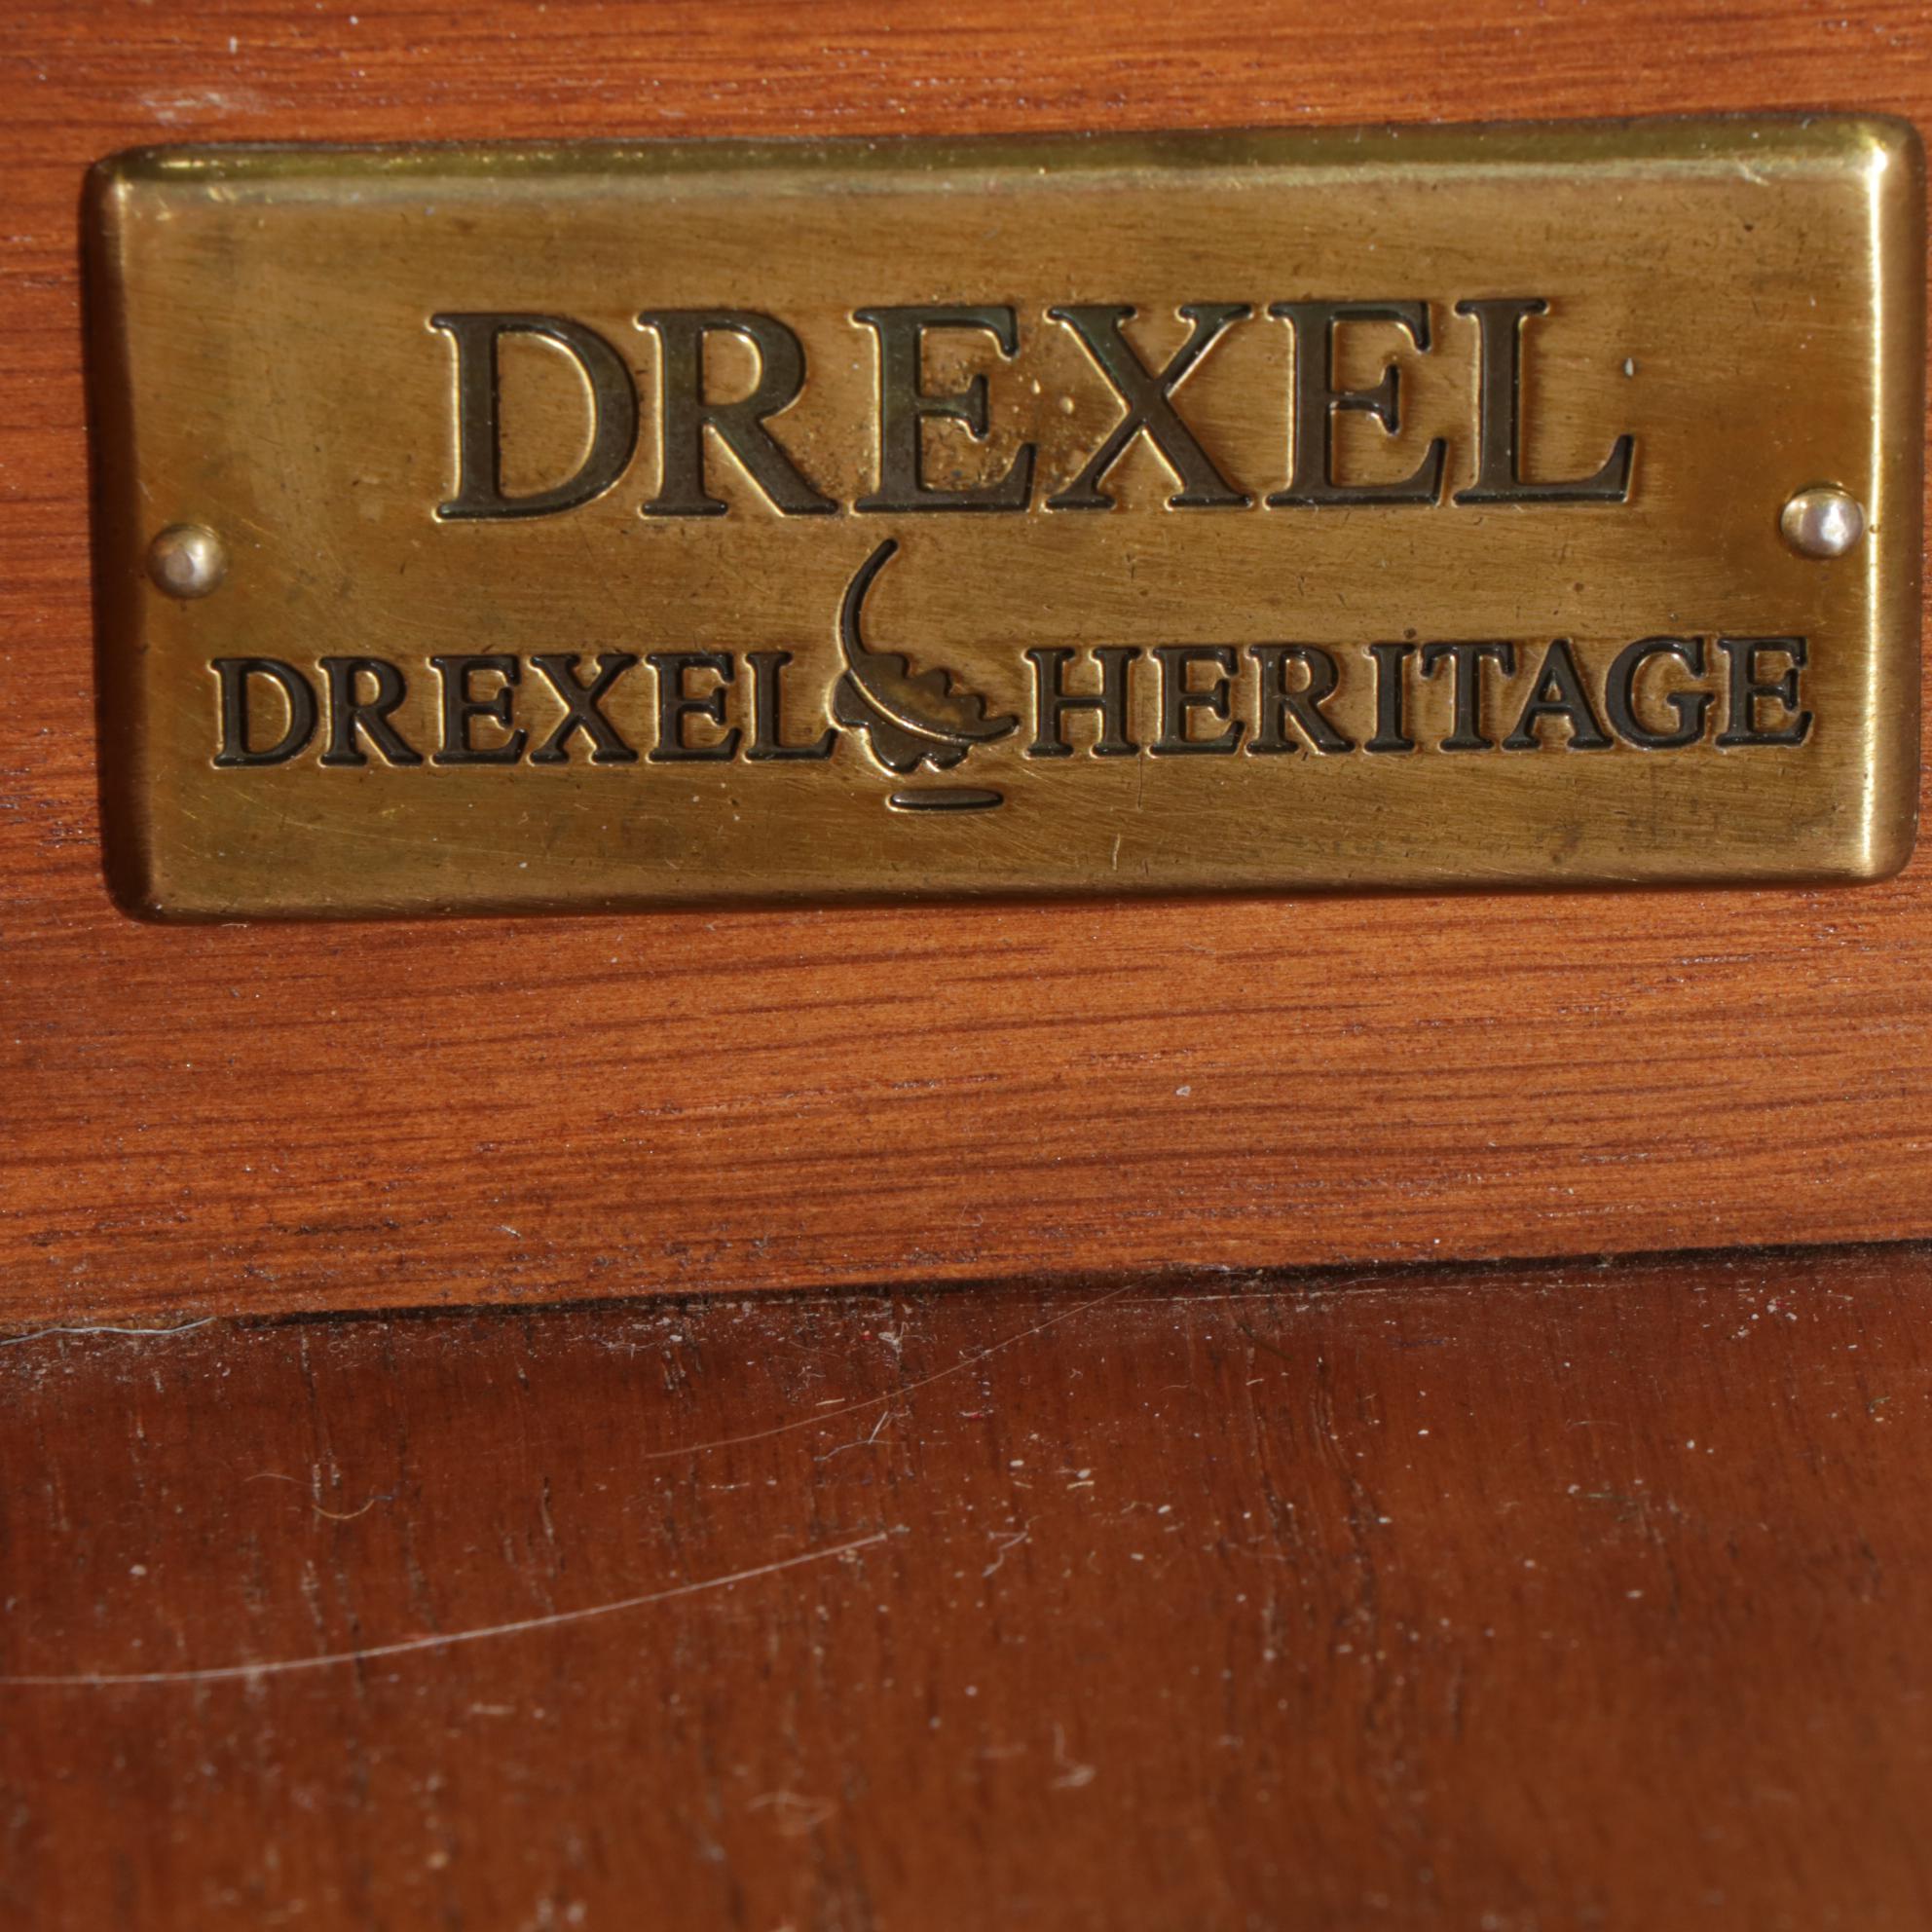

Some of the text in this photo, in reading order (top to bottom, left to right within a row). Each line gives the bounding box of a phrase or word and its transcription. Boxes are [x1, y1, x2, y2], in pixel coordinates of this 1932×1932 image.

[428, 297, 1637, 522] DREXEL
[208, 636, 1814, 769] DREXEL HERITAGE
